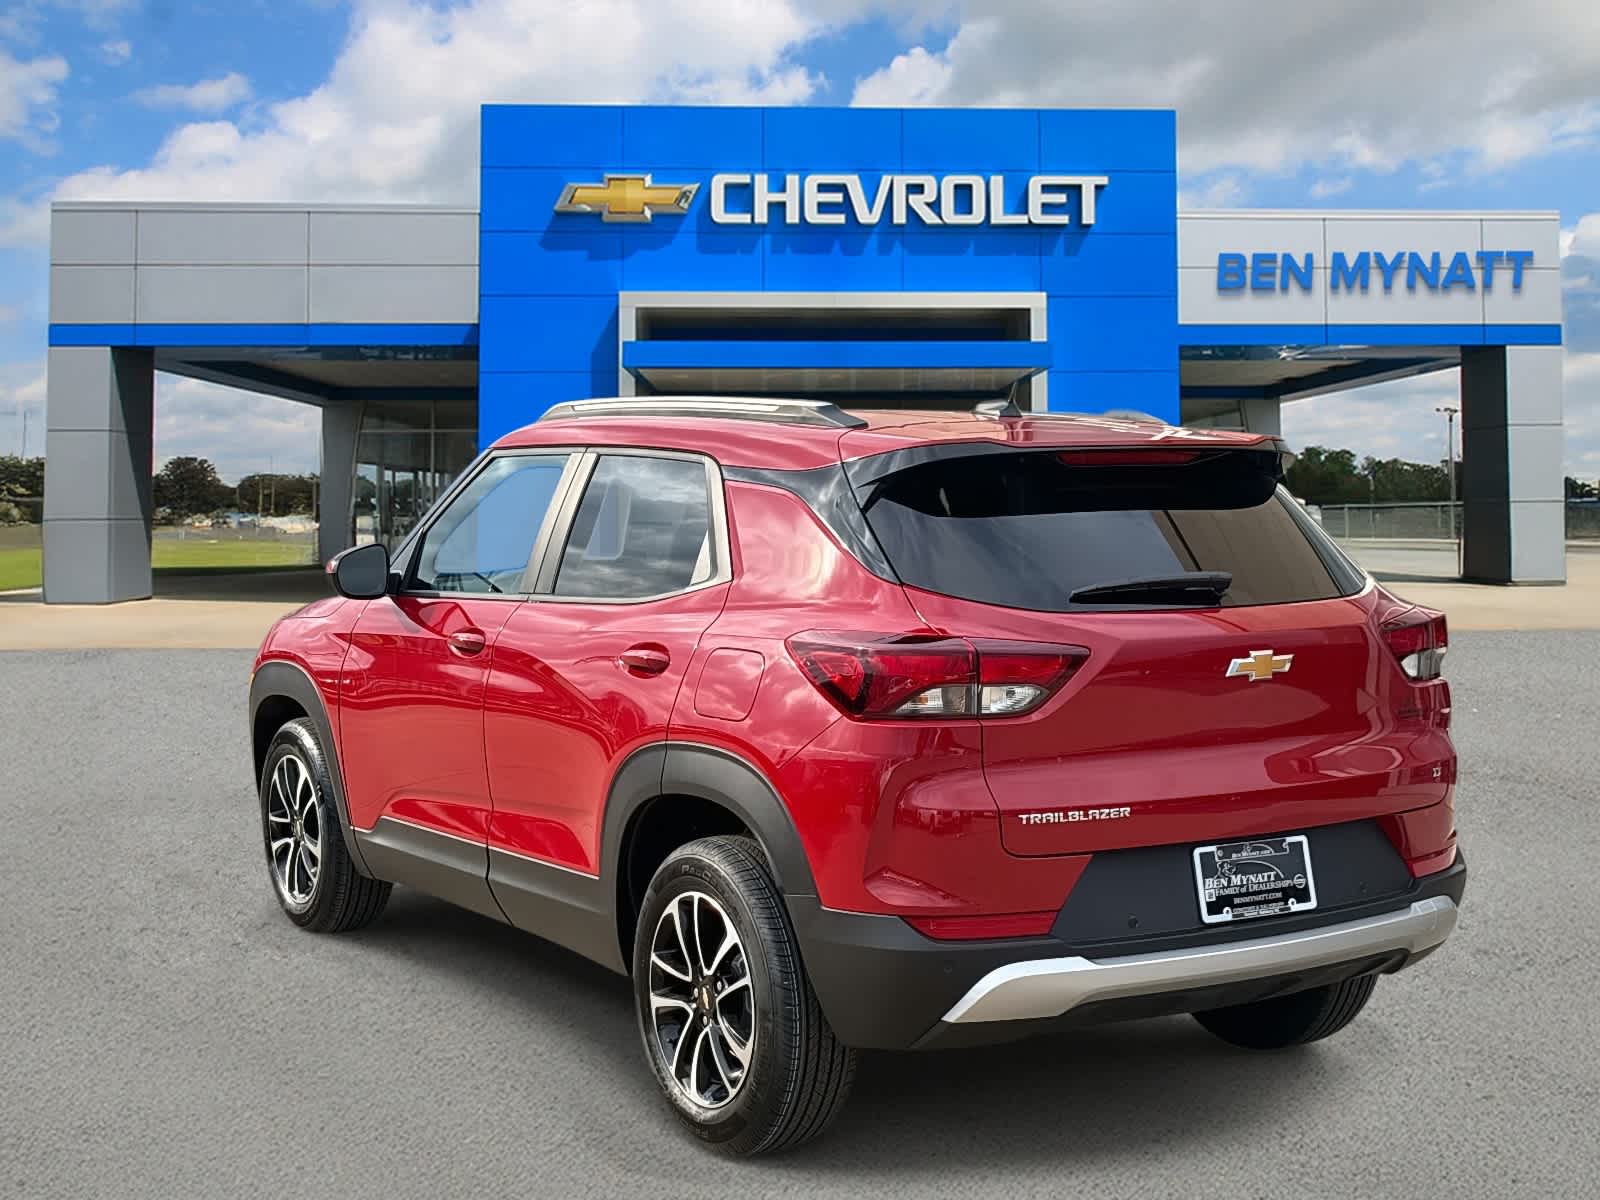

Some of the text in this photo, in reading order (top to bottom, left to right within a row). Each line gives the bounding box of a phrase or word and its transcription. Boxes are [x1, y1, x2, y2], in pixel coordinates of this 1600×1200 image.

[710, 173, 1109, 226] CHEVROLET
[1217, 250, 1534, 290] BEN MYNATT
[1018, 807, 1131, 825] TRAILBLAZER
[1205, 871, 1277, 891] BEN MYNATT
